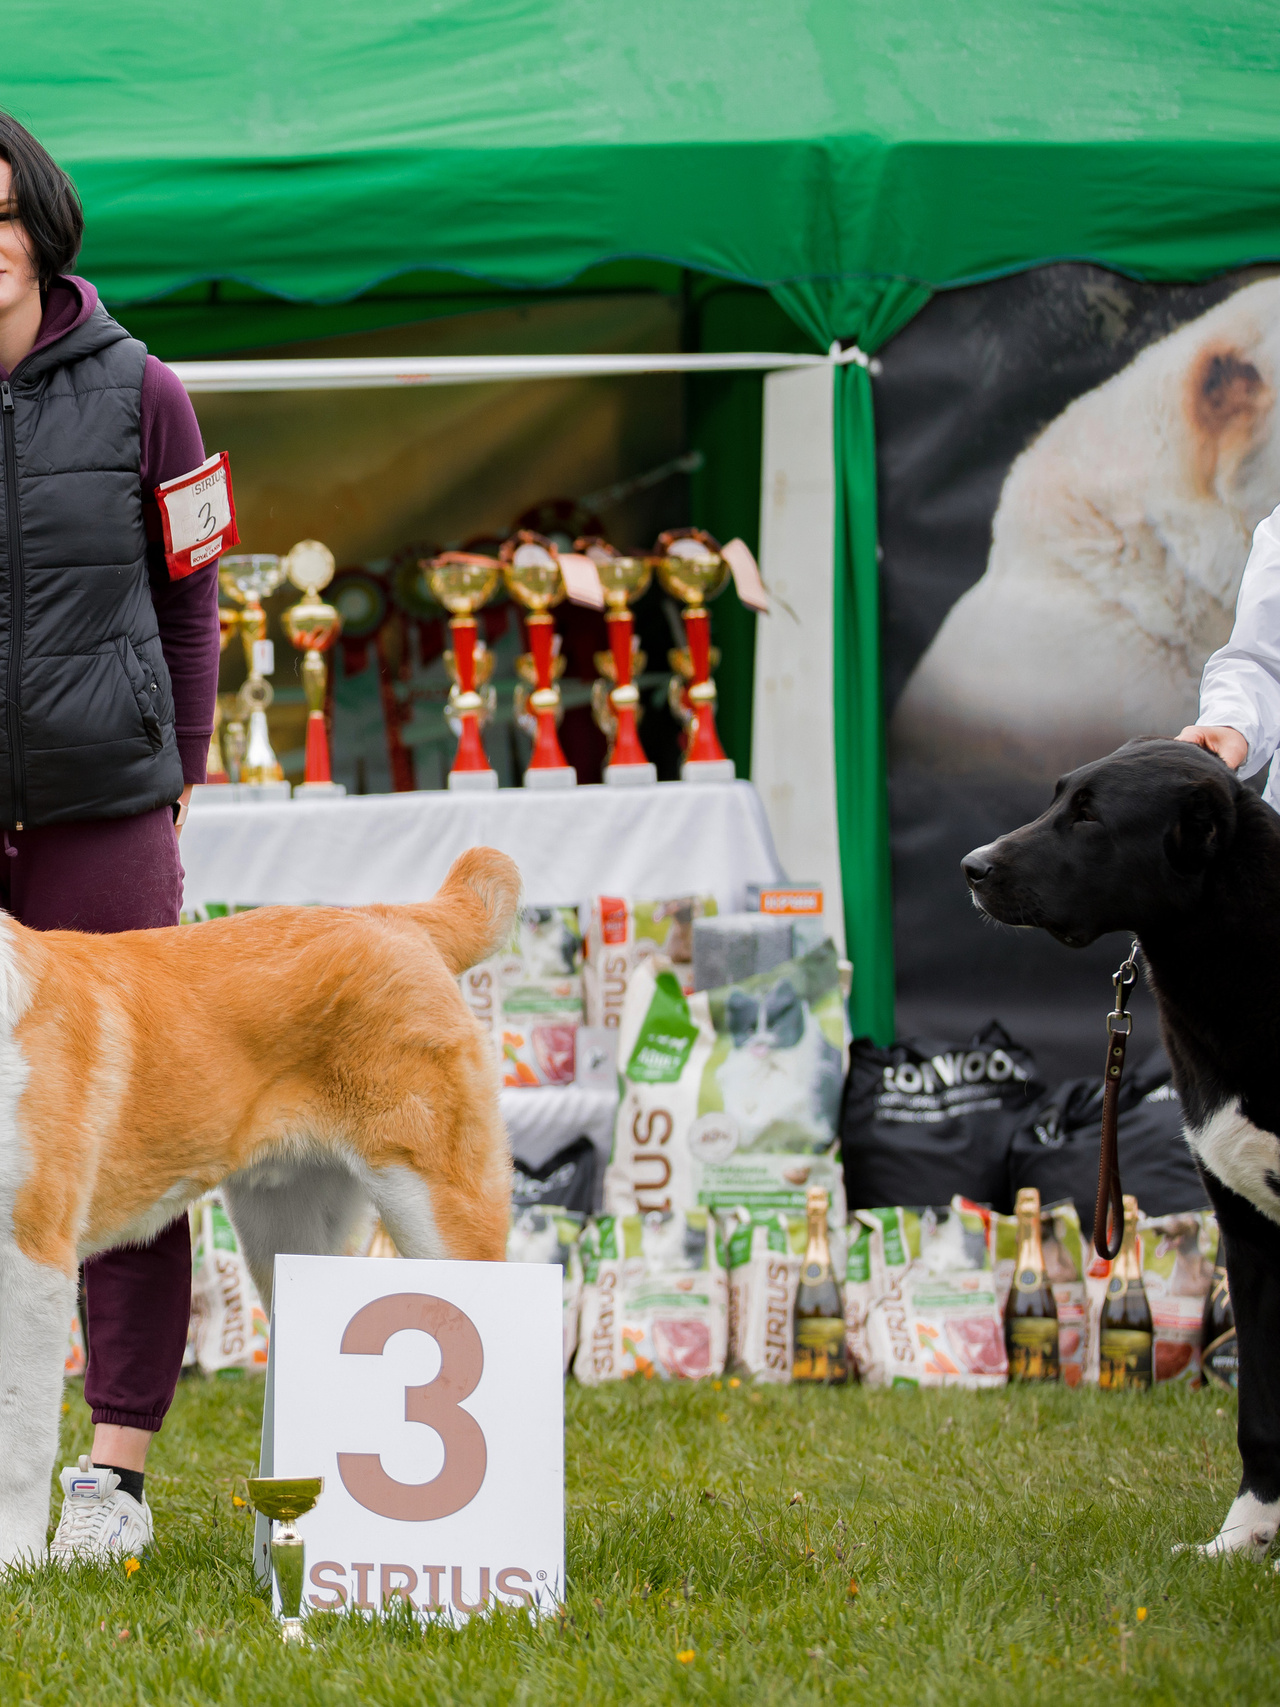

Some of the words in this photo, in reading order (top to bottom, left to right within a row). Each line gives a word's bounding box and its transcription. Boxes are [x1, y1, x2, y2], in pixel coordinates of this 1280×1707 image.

[196, 502, 216, 542] 3
[765, 1262, 789, 1371] SIRIUS
[336, 1292, 488, 1523] 3
[308, 1560, 533, 1613] SIRIUS
